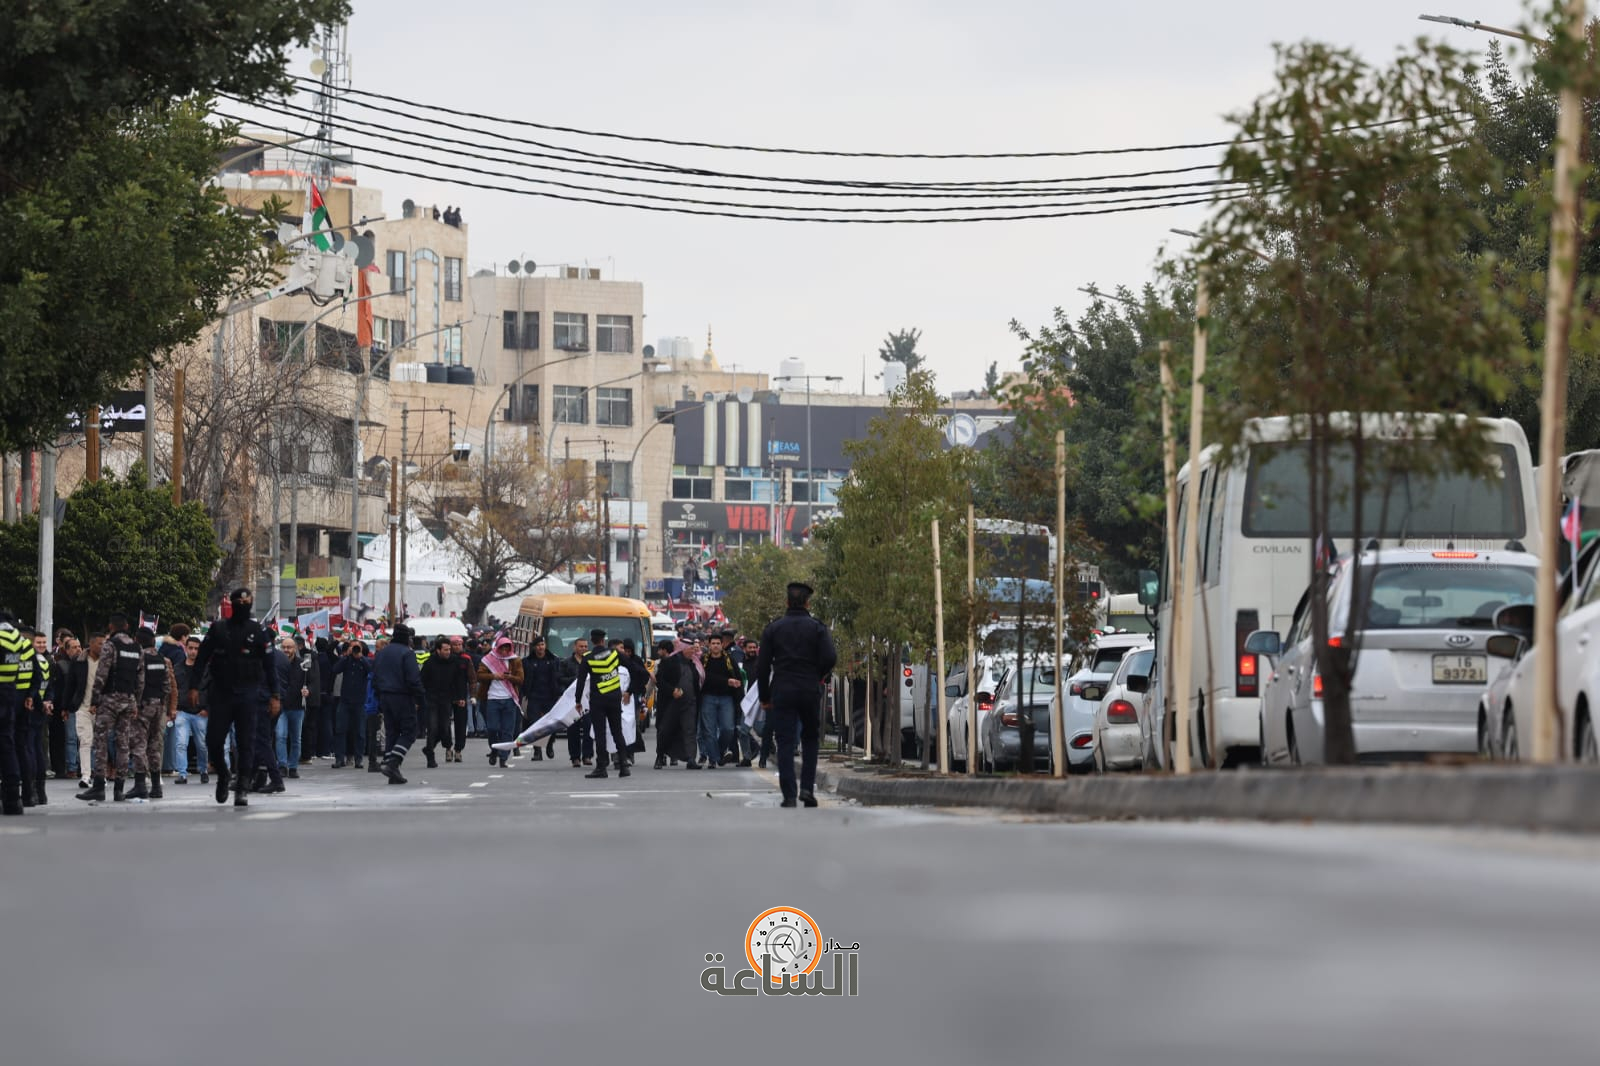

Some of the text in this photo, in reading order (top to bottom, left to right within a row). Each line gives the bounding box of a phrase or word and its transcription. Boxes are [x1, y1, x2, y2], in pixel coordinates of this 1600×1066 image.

[1252, 545, 1302, 553] CIVILIAN
[1457, 656, 1472, 668] 16
[1443, 668, 1483, 680] 93721
